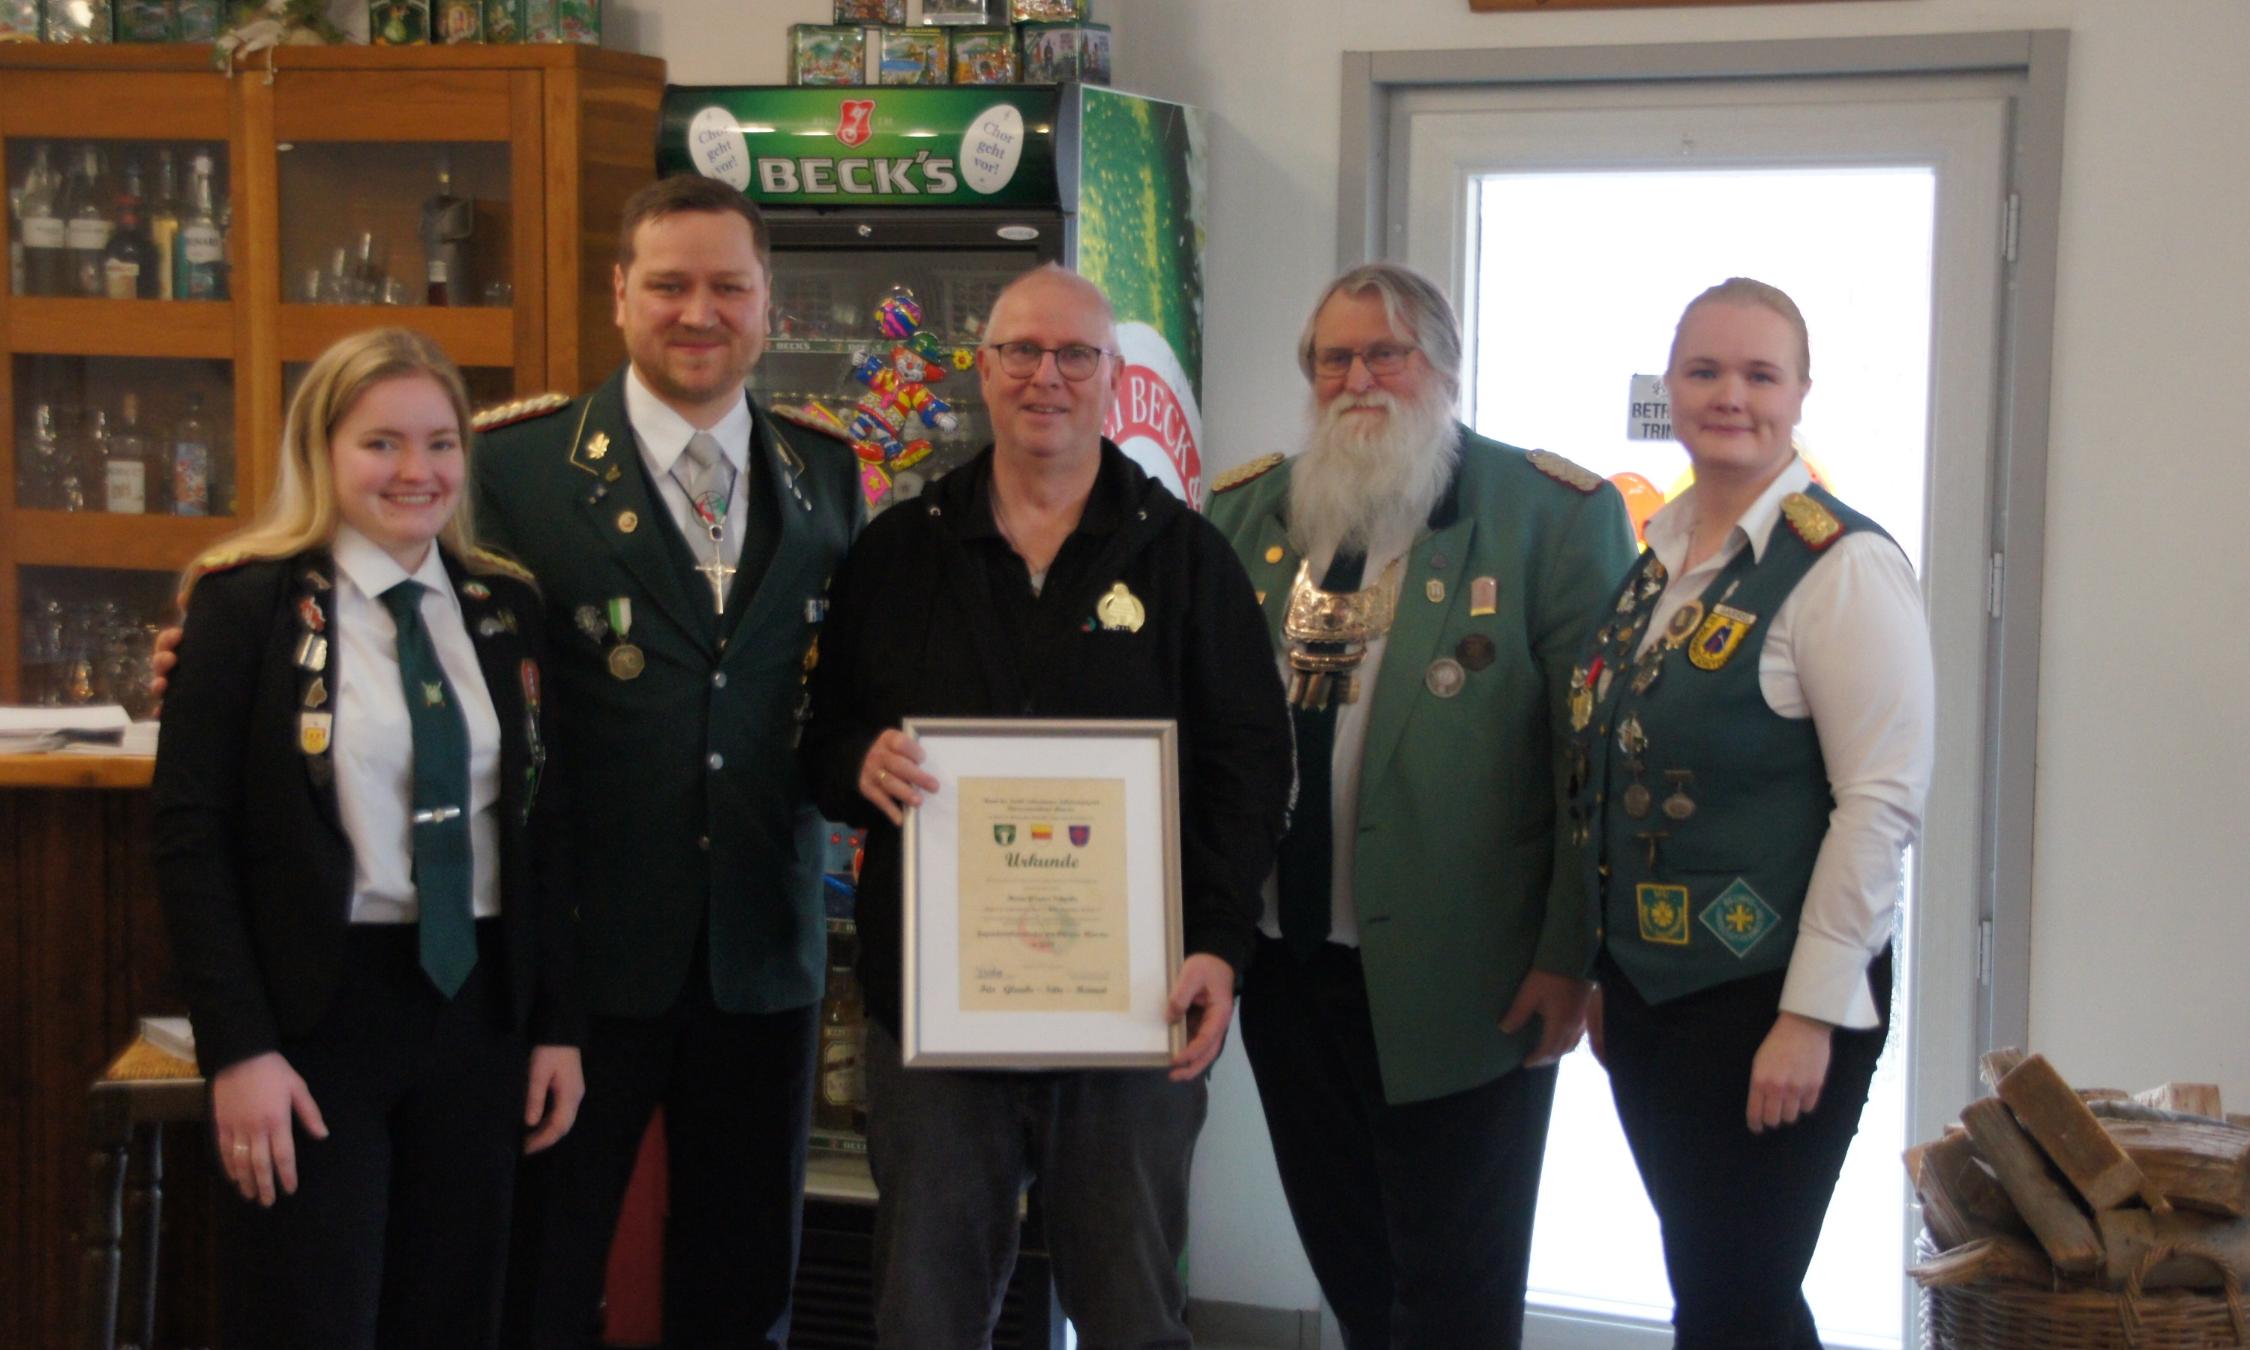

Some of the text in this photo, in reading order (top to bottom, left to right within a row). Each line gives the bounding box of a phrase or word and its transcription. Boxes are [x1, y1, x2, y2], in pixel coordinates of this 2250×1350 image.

[983, 121, 1014, 144] Chor
[706, 140, 732, 163] geht
[976, 141, 1005, 159] geht
[757, 150, 958, 195] BECK'S
[974, 157, 1000, 175] vor!
[1130, 376, 1192, 476] BECK
[1005, 853, 1079, 869] Urkunde
